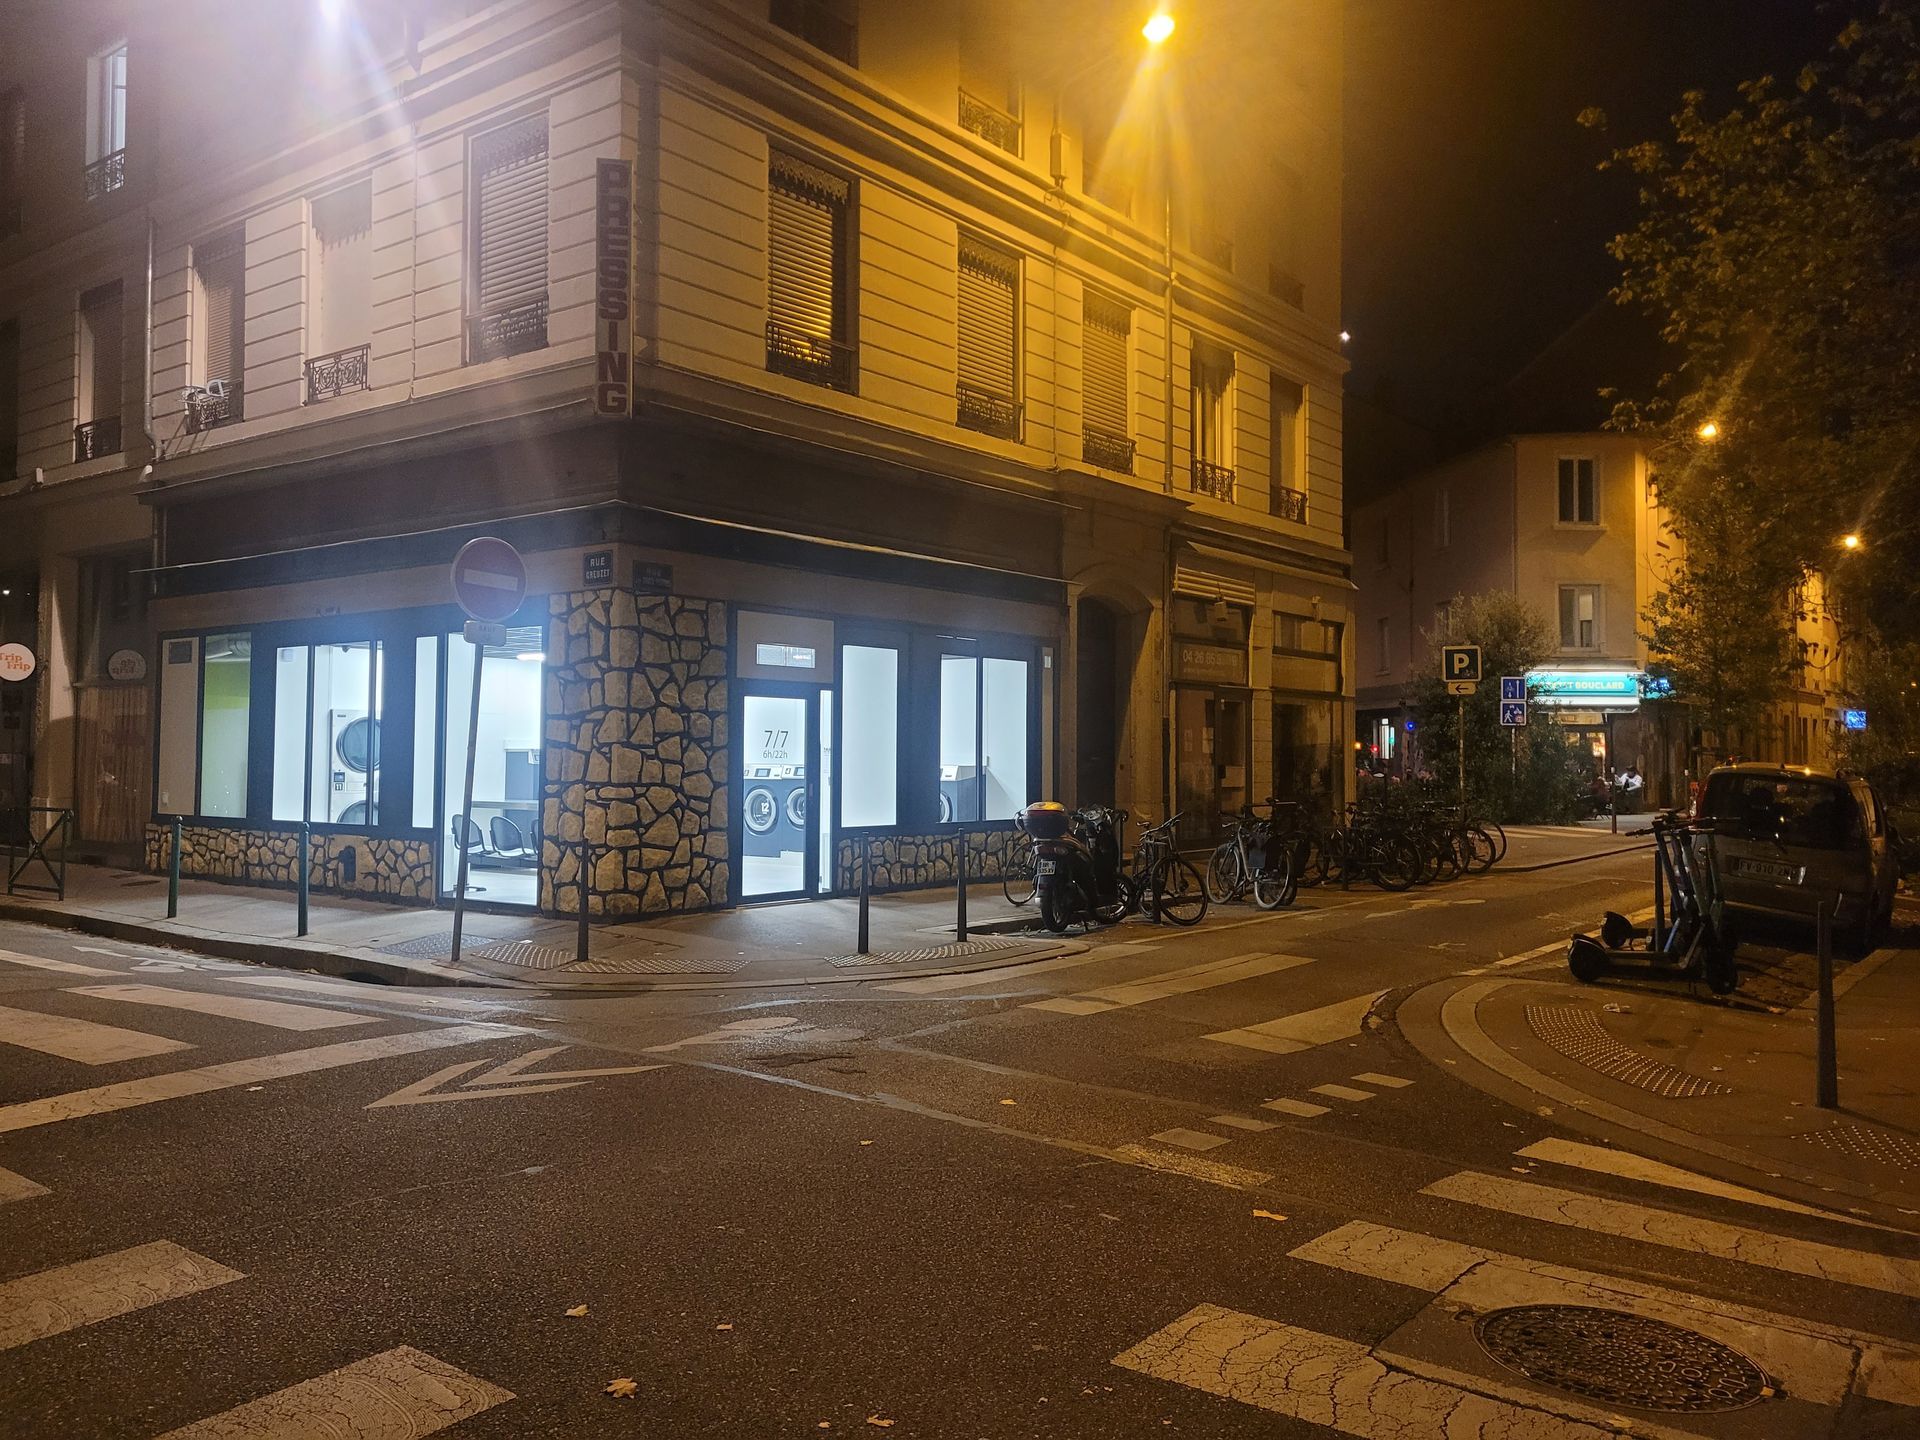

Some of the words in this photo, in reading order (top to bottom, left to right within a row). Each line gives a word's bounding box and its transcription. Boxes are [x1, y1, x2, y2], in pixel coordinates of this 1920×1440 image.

[597, 162, 629, 414] PRESSING
[590, 556, 605, 567] RUE
[1453, 653, 1470, 674] P
[1575, 681, 1625, 690] BOUCLARD
[764, 729, 789, 749] 7/7
[762, 749, 788, 759] 6h/22h
